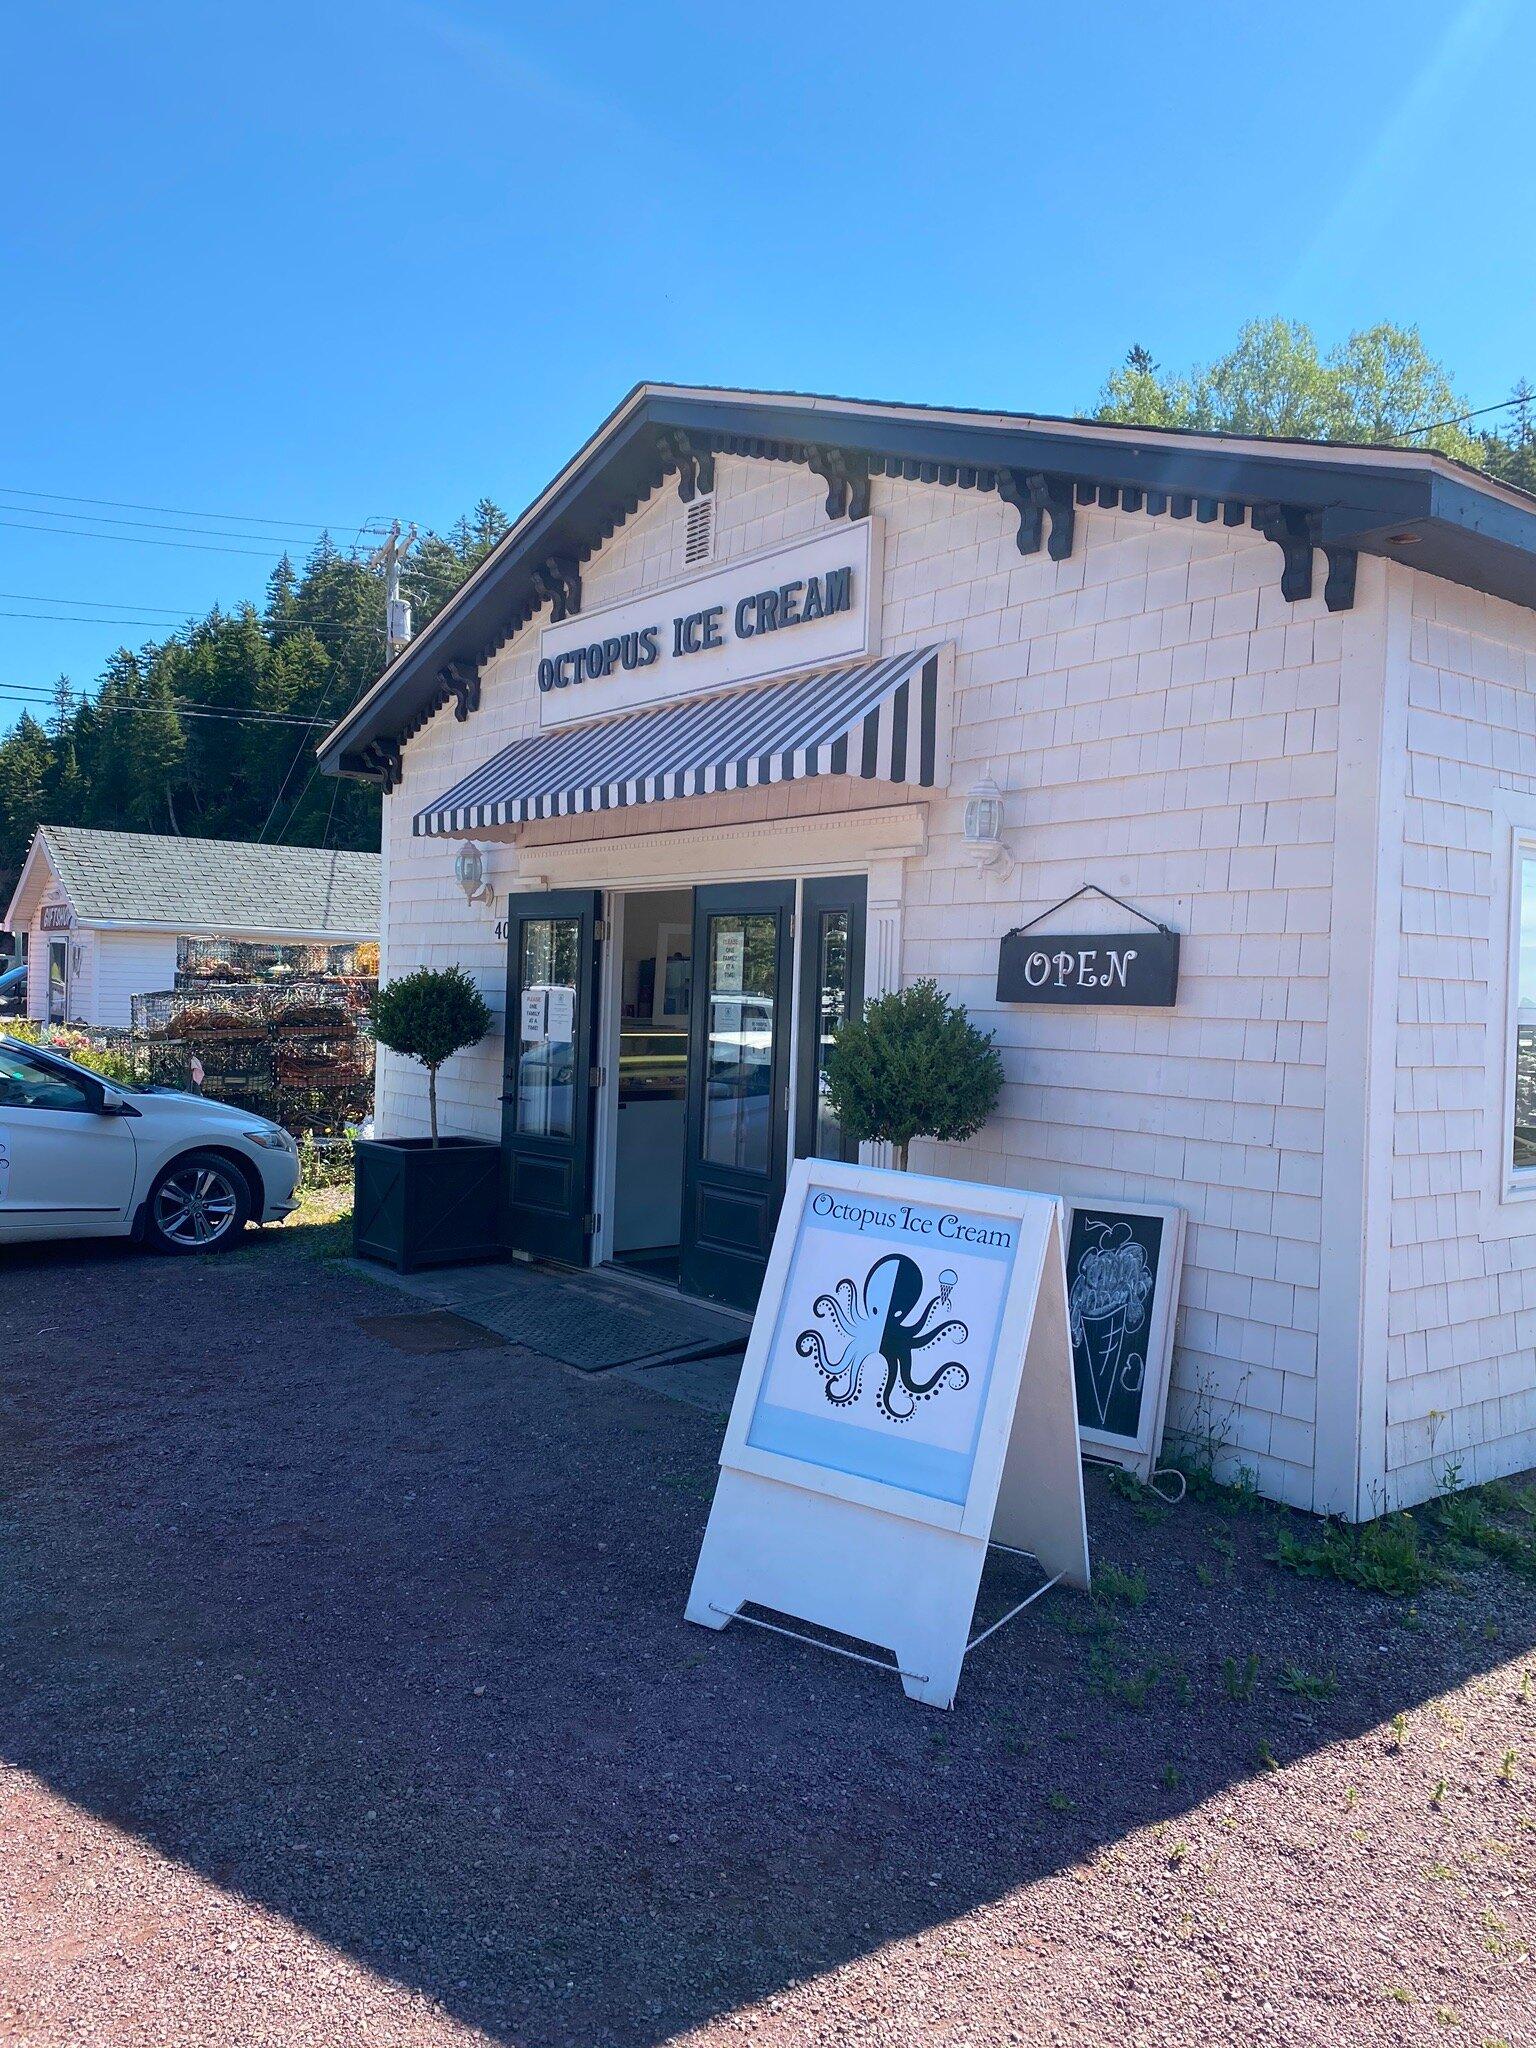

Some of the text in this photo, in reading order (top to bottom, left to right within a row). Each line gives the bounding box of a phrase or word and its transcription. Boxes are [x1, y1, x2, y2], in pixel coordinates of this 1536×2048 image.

[538, 566, 852, 692] OCTOPUS ICE CREAM
[1024, 950, 1138, 987] OPEN
[812, 1192, 1011, 1248] Octopus Ice Cream
